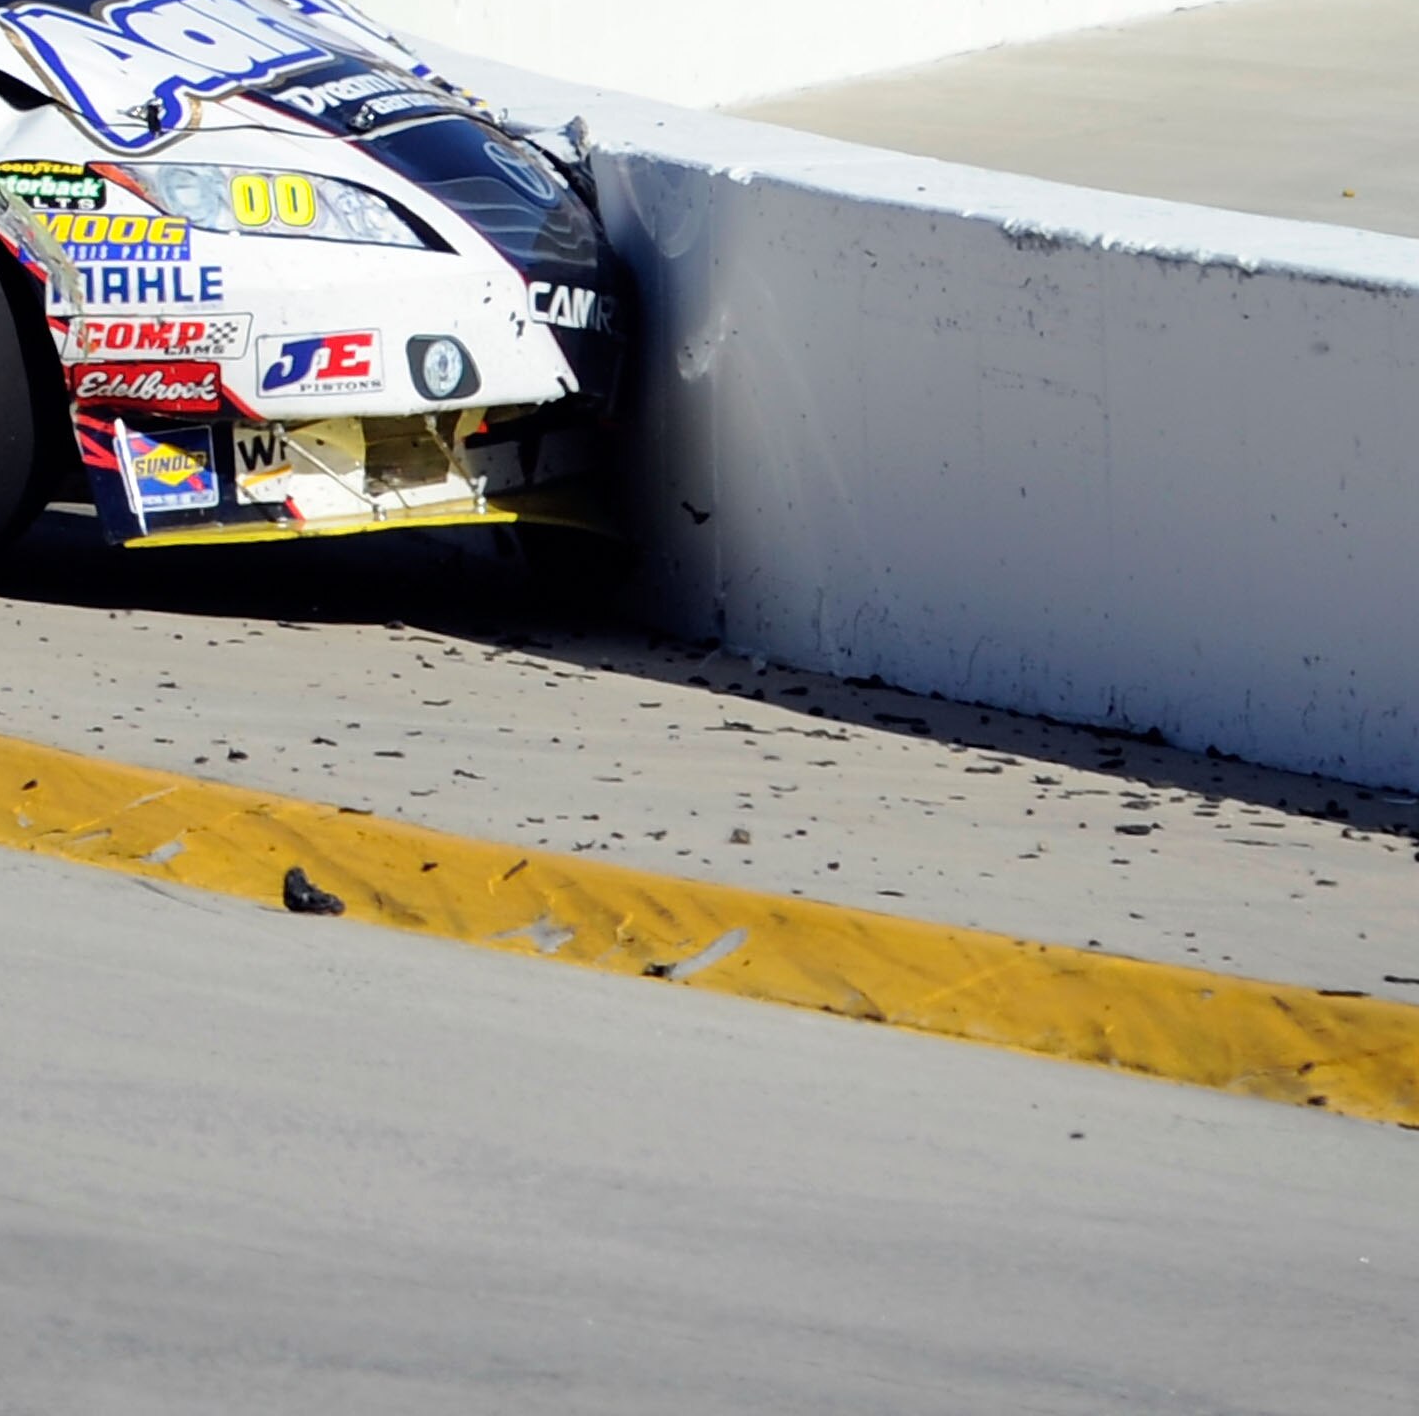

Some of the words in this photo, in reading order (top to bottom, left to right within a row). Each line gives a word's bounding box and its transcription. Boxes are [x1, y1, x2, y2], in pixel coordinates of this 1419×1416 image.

[3, 176, 102, 198] torback
[231, 173, 316, 228] 00
[32, 198, 96, 209] LTS
[35, 213, 188, 244] MOOG
[120, 245, 182, 260] PARTS
[52, 267, 224, 304] MAHLE
[76, 322, 205, 350] COMP
[164, 343, 226, 356] CAMS
[263, 334, 373, 391] JE
[76, 371, 218, 400] Edelbrock
[300, 381, 382, 392] PISTONS
[135, 450, 207, 476] SUNOCO
